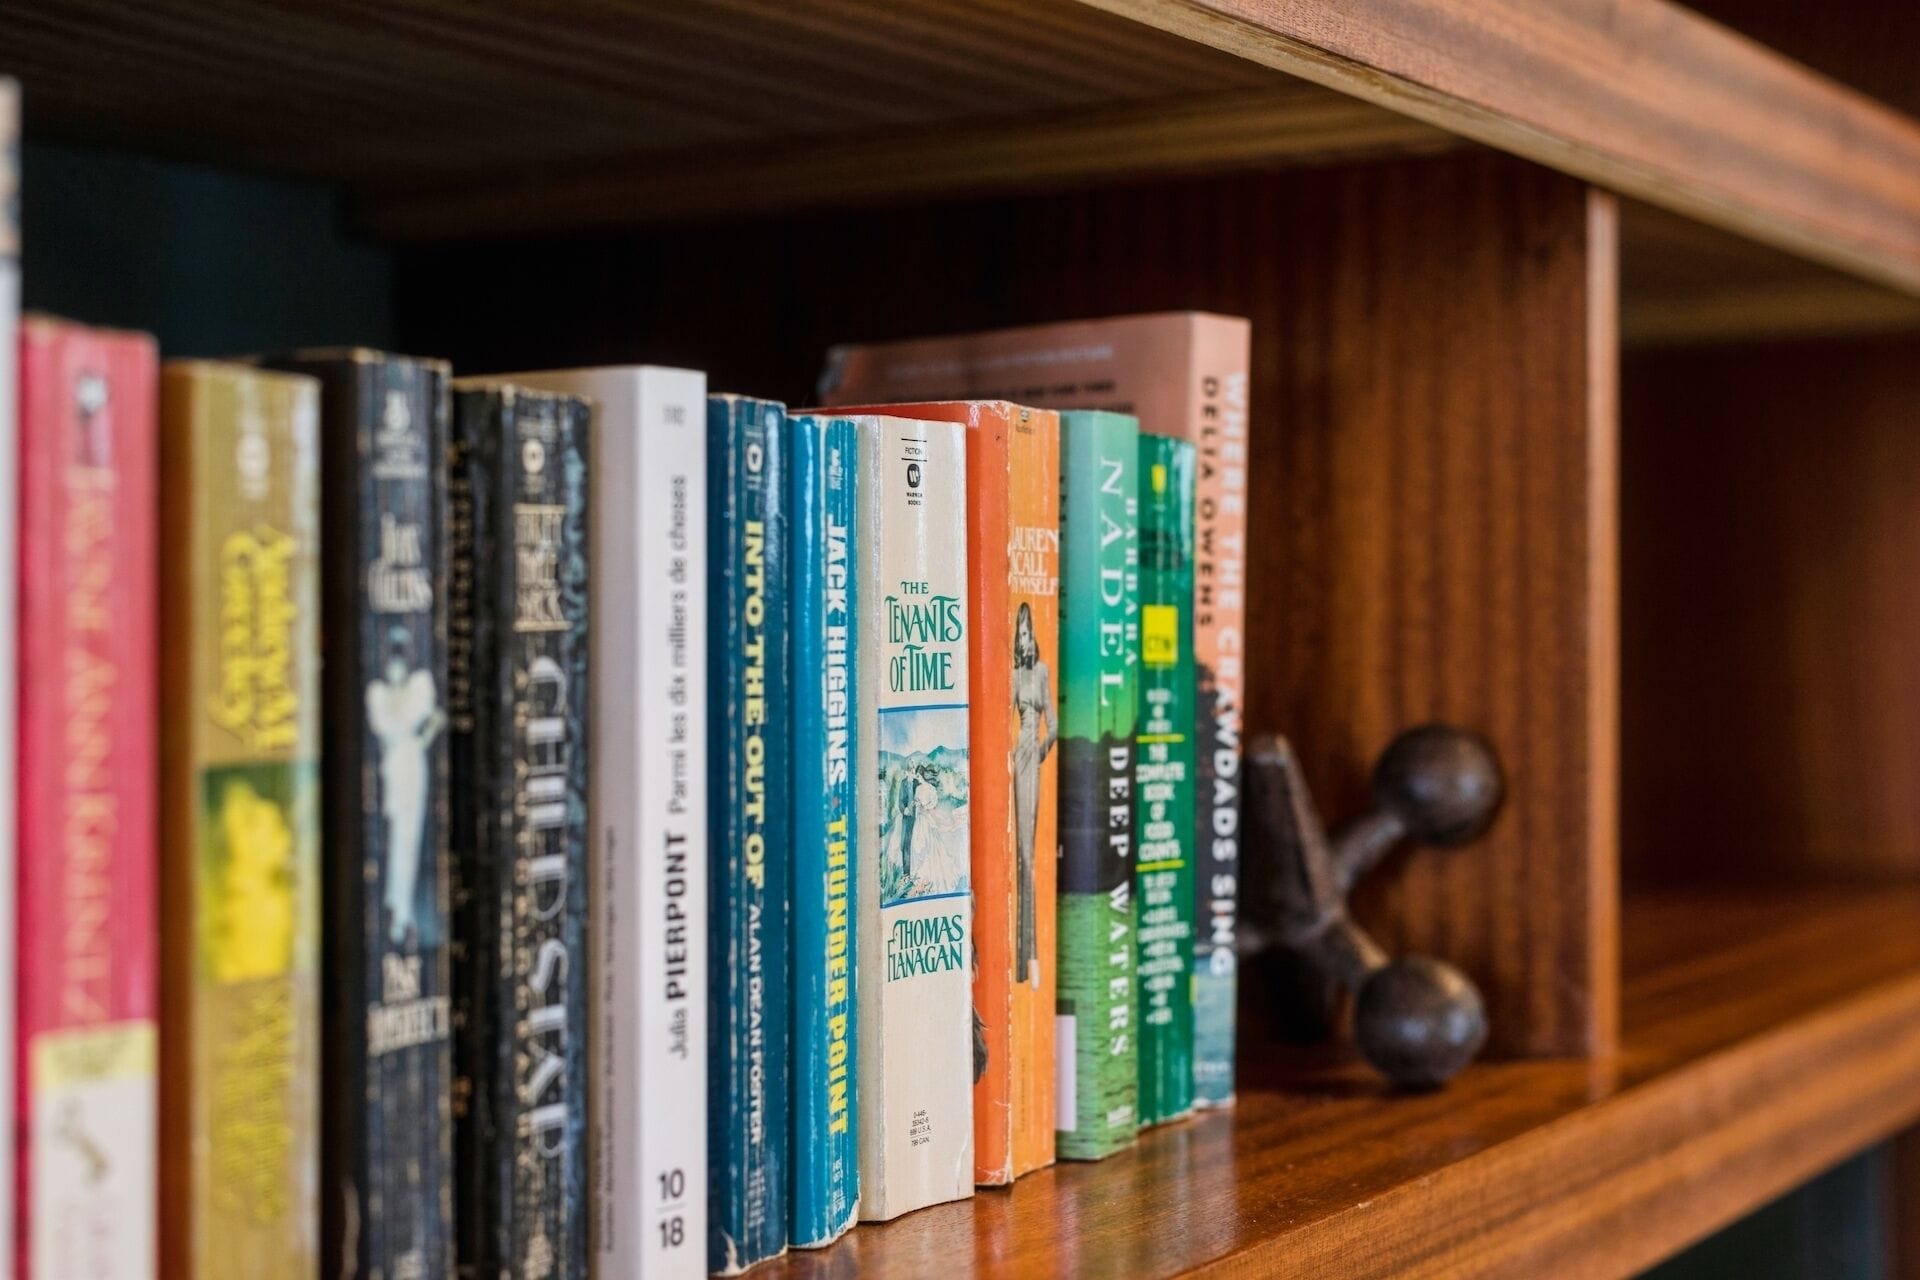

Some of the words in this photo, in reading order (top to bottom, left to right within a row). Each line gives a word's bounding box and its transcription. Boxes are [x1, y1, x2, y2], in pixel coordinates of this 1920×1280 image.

[1203, 376, 1218, 480] DELIA
[1221, 372, 1247, 514] WHERE
[669, 558, 688, 583] de
[744, 520, 765, 627] INTO
[825, 514, 847, 612] JACK
[901, 581, 929, 595] THE
[1101, 456, 1124, 707] NADEL
[1125, 498, 1138, 667] BARBARA
[1198, 500, 1216, 627] OWENS
[1217, 533, 1244, 609] THE
[884, 595, 963, 643] TENANTS
[744, 635, 765, 726] THE
[823, 626, 849, 786] HIGGINS
[889, 656, 907, 693] OF
[903, 644, 955, 692] TIME
[744, 735, 765, 824] OUT
[1212, 625, 1243, 861] CRAWDADS
[1109, 746, 1130, 858] DEEP
[744, 833, 765, 889] OF
[665, 829, 688, 1000] PIERPONT
[749, 904, 765, 971] ALAN
[825, 815, 847, 1008] THUNDER
[893, 914, 964, 950] THOMAS
[1209, 873, 1238, 975] SING
[887, 942, 963, 982] FLANAGAN
[1109, 880, 1130, 1057] WATERS
[668, 1008, 687, 1060] Julia
[749, 978, 765, 1045] DEAN
[749, 1051, 764, 1145] FOSTER
[828, 1013, 850, 1134] POINT
[659, 1168, 685, 1200] 10
[659, 1216, 685, 1248] 18
